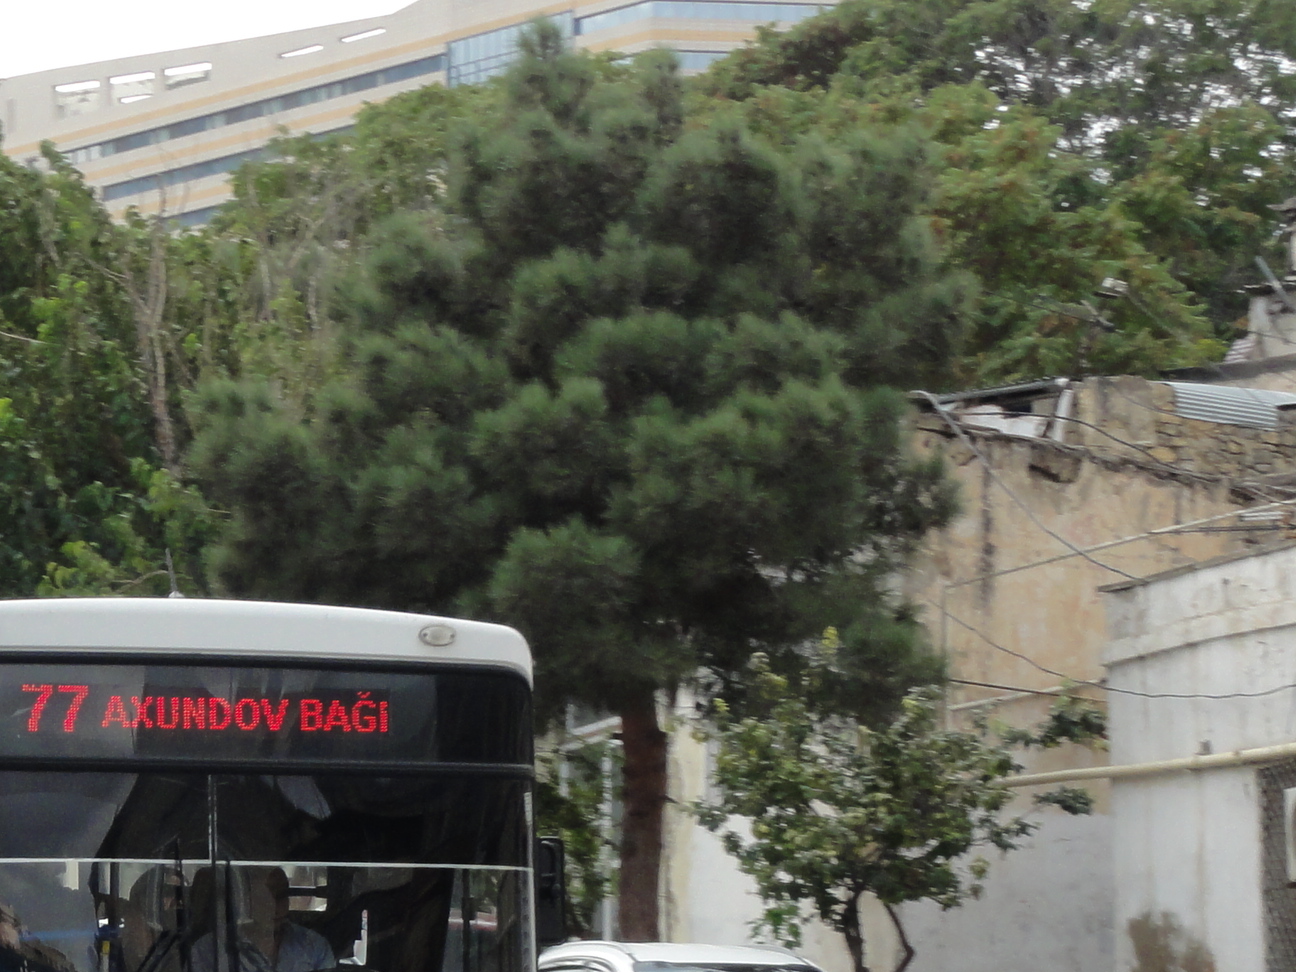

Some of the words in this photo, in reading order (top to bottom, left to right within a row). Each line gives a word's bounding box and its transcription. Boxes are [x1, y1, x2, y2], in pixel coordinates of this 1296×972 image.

[21, 684, 89, 733] 77
[101, 695, 289, 732] AXUNDOV
[300, 691, 388, 733] BAĞI
